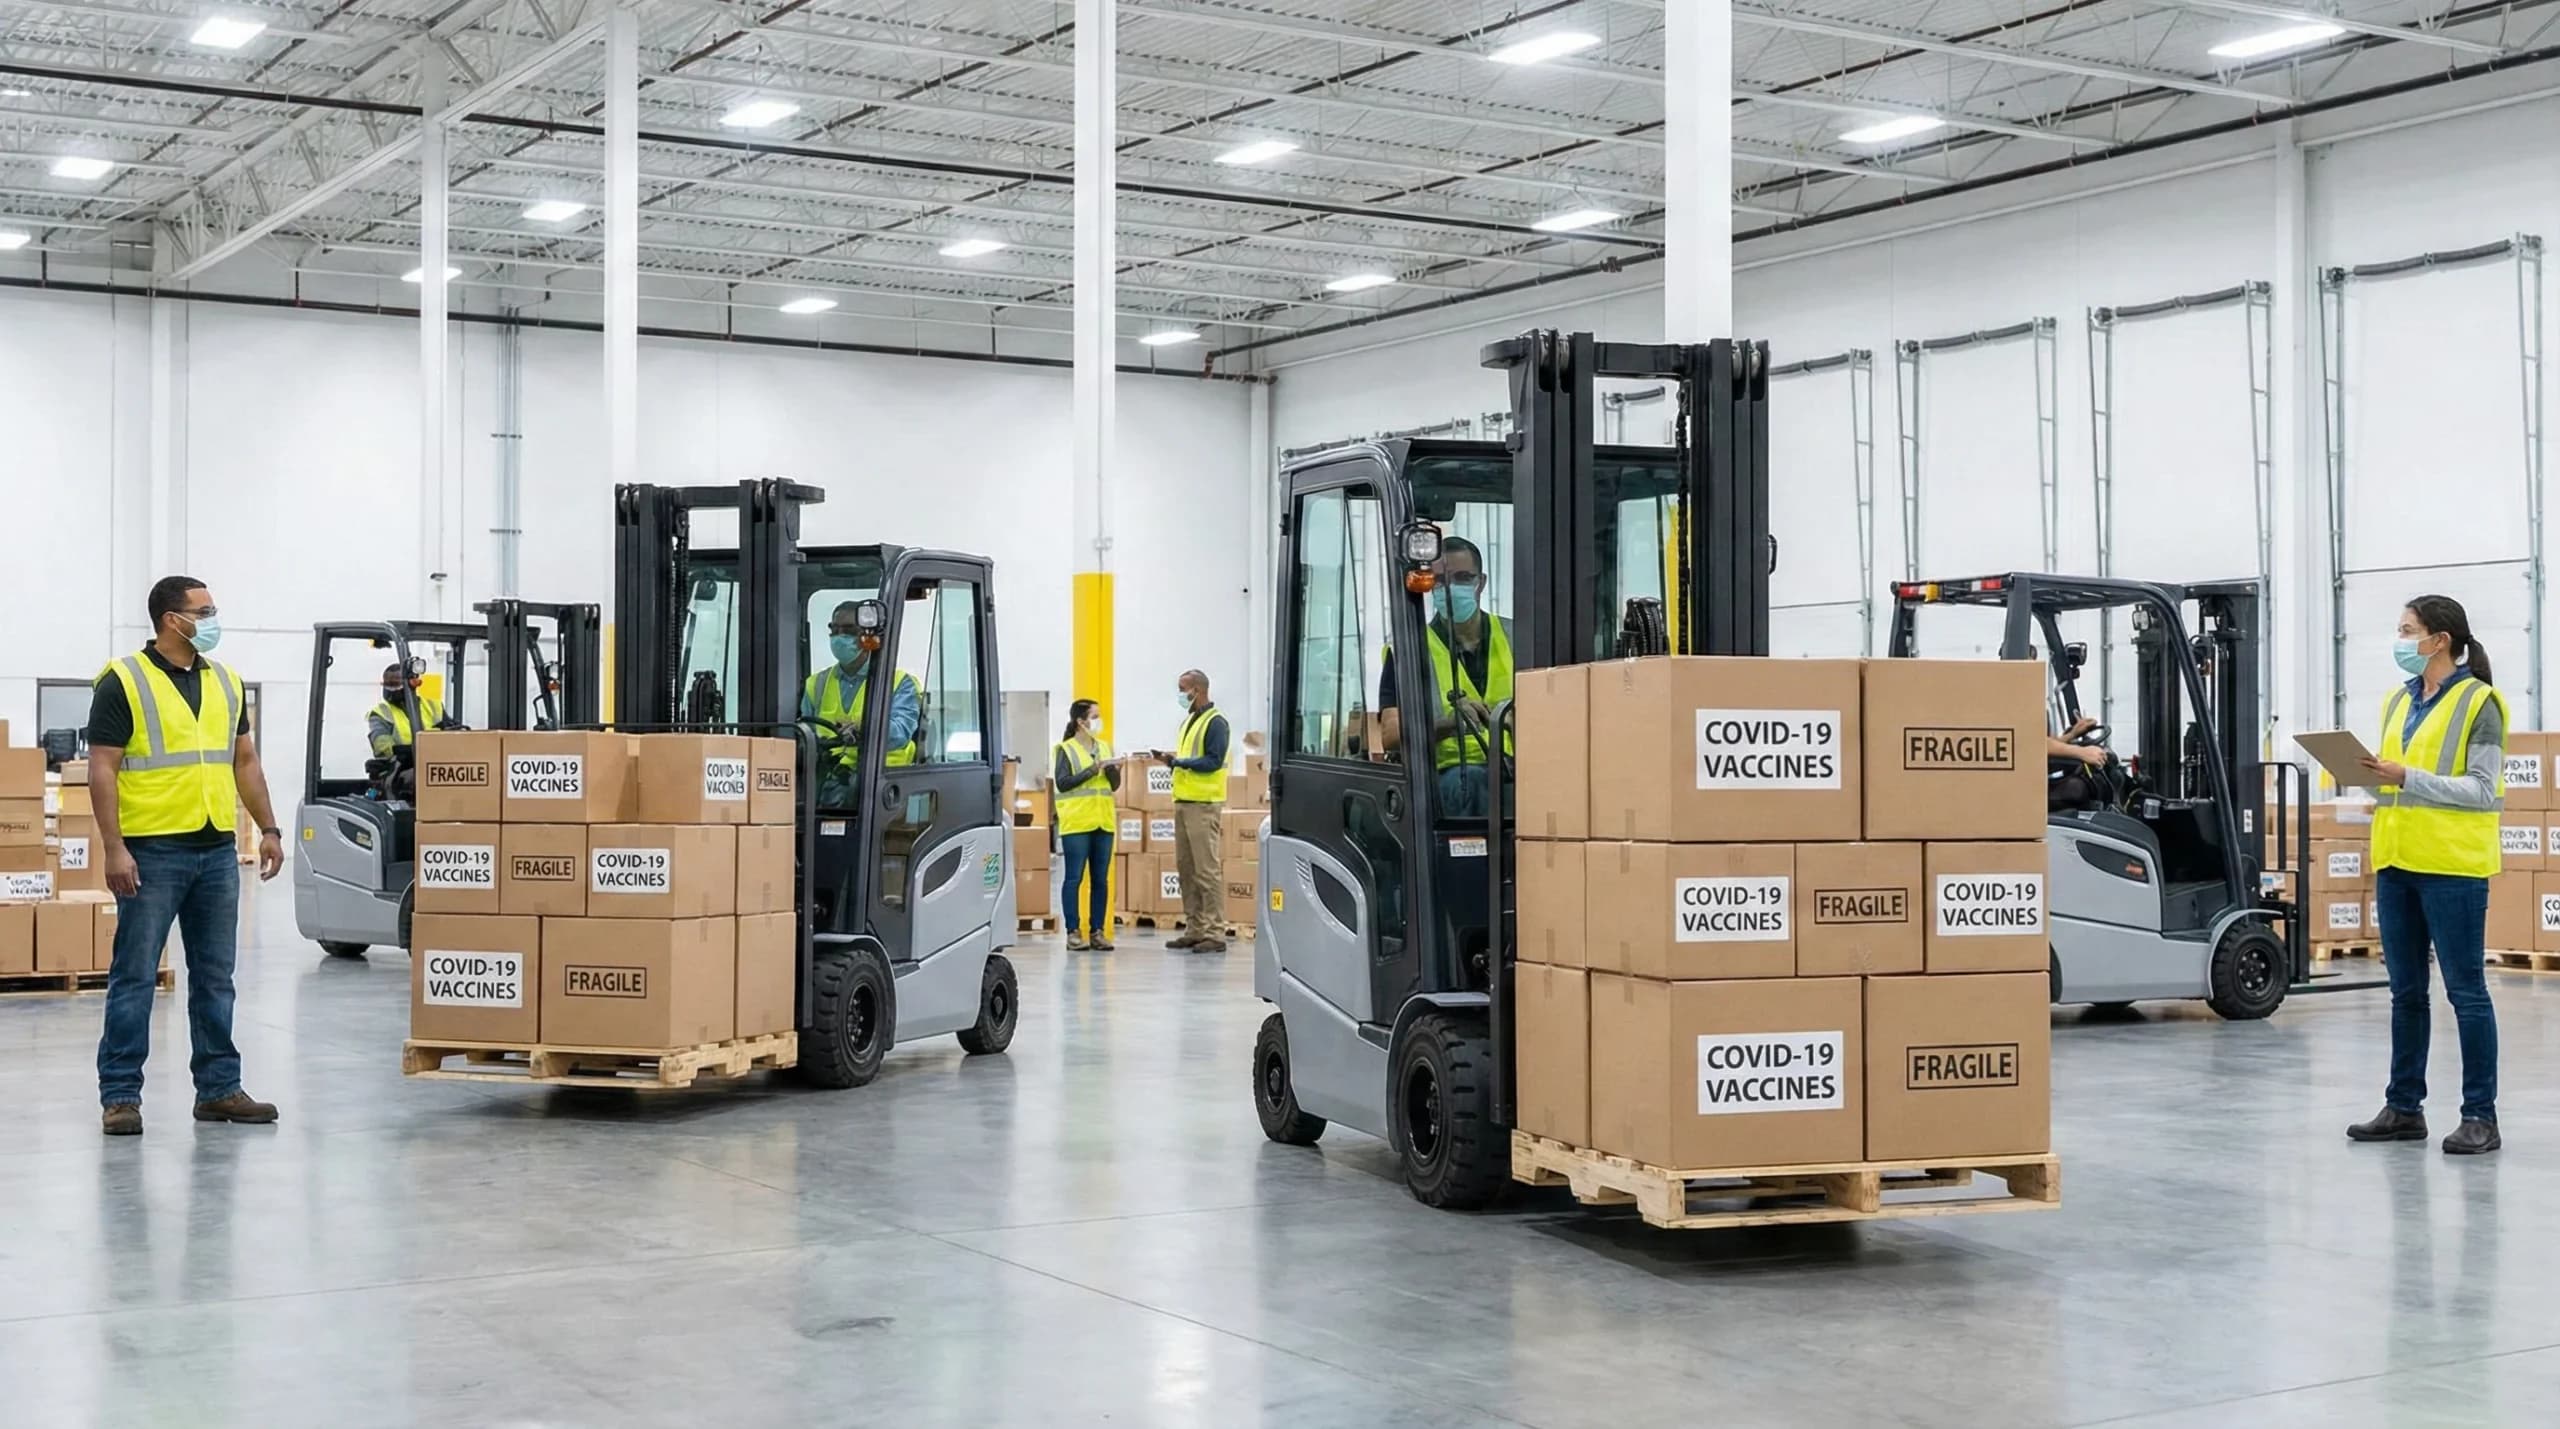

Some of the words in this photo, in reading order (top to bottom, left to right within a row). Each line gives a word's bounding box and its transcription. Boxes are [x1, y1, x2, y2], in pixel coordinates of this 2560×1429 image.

[1706, 721, 1831, 745] COVID-19
[1911, 737, 2008, 761] FRAGILE
[431, 767, 484, 782] FRAGILE
[512, 761, 578, 774] COVID-19
[1704, 755, 1833, 778] VACCINES
[511, 779, 578, 792] VACCINES
[424, 851, 489, 864] COVID-19
[598, 854, 664, 868] COVID-19
[424, 869, 490, 882] VACCINES
[516, 862, 570, 875] FRAGILE
[598, 872, 665, 886] VACCINES
[1684, 887, 1781, 905] COVID-19
[1944, 883, 2036, 901] COVID-19
[1820, 895, 1902, 917] FRAGILE
[1683, 912, 1781, 931] VACCINES
[1943, 908, 2037, 926] VACCINES
[430, 958, 516, 976] COVID-19
[429, 980, 516, 999] VACCINES
[569, 972, 641, 991] FRAGILE
[1708, 1043, 1833, 1069] COVID-19
[1914, 1053, 2012, 1080] FRAGILE
[1706, 1075, 1835, 1102] VACCINES
